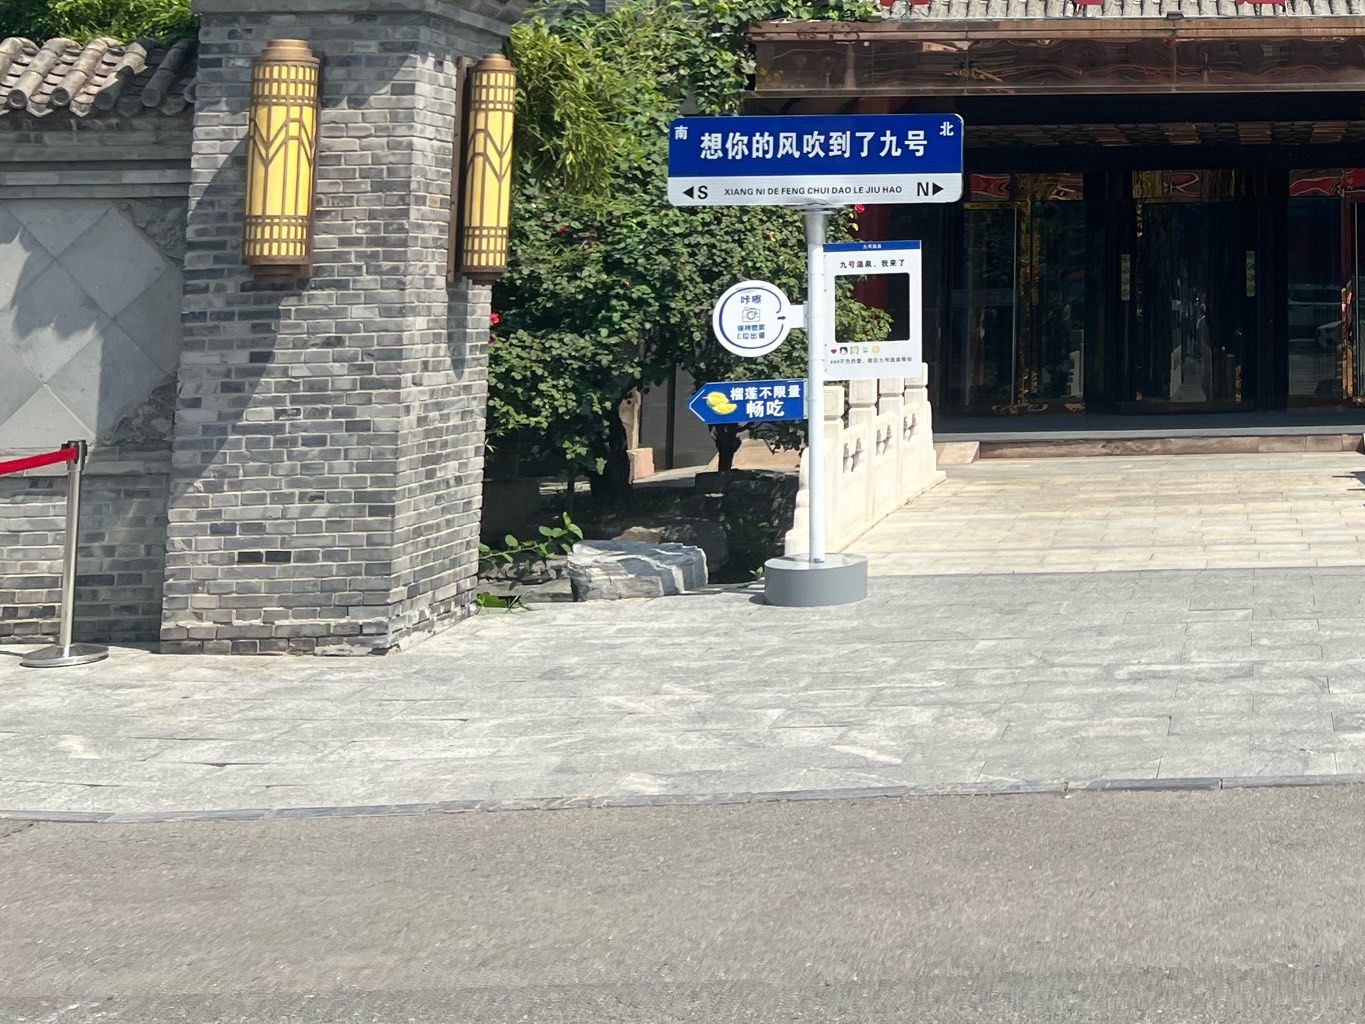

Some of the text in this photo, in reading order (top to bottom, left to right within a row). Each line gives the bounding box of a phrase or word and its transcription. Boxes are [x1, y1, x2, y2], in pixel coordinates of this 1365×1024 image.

[674, 126, 688, 140] 南
[939, 121, 954, 136] 北
[700, 130, 928, 160] 想你的风吹到了九号
[697, 185, 708, 199] S
[724, 187, 754, 196] XIANG
[768, 187, 779, 195] DE
[781, 187, 805, 195] FENG
[832, 186, 852, 194] DAO
[853, 186, 864, 194] LE
[865, 186, 880, 194] JIU
[882, 185, 903, 193] HAO
[917, 182, 929, 196] N
[730, 384, 801, 401] 榴莲不限量
[746, 399, 785, 418] 畅吃
